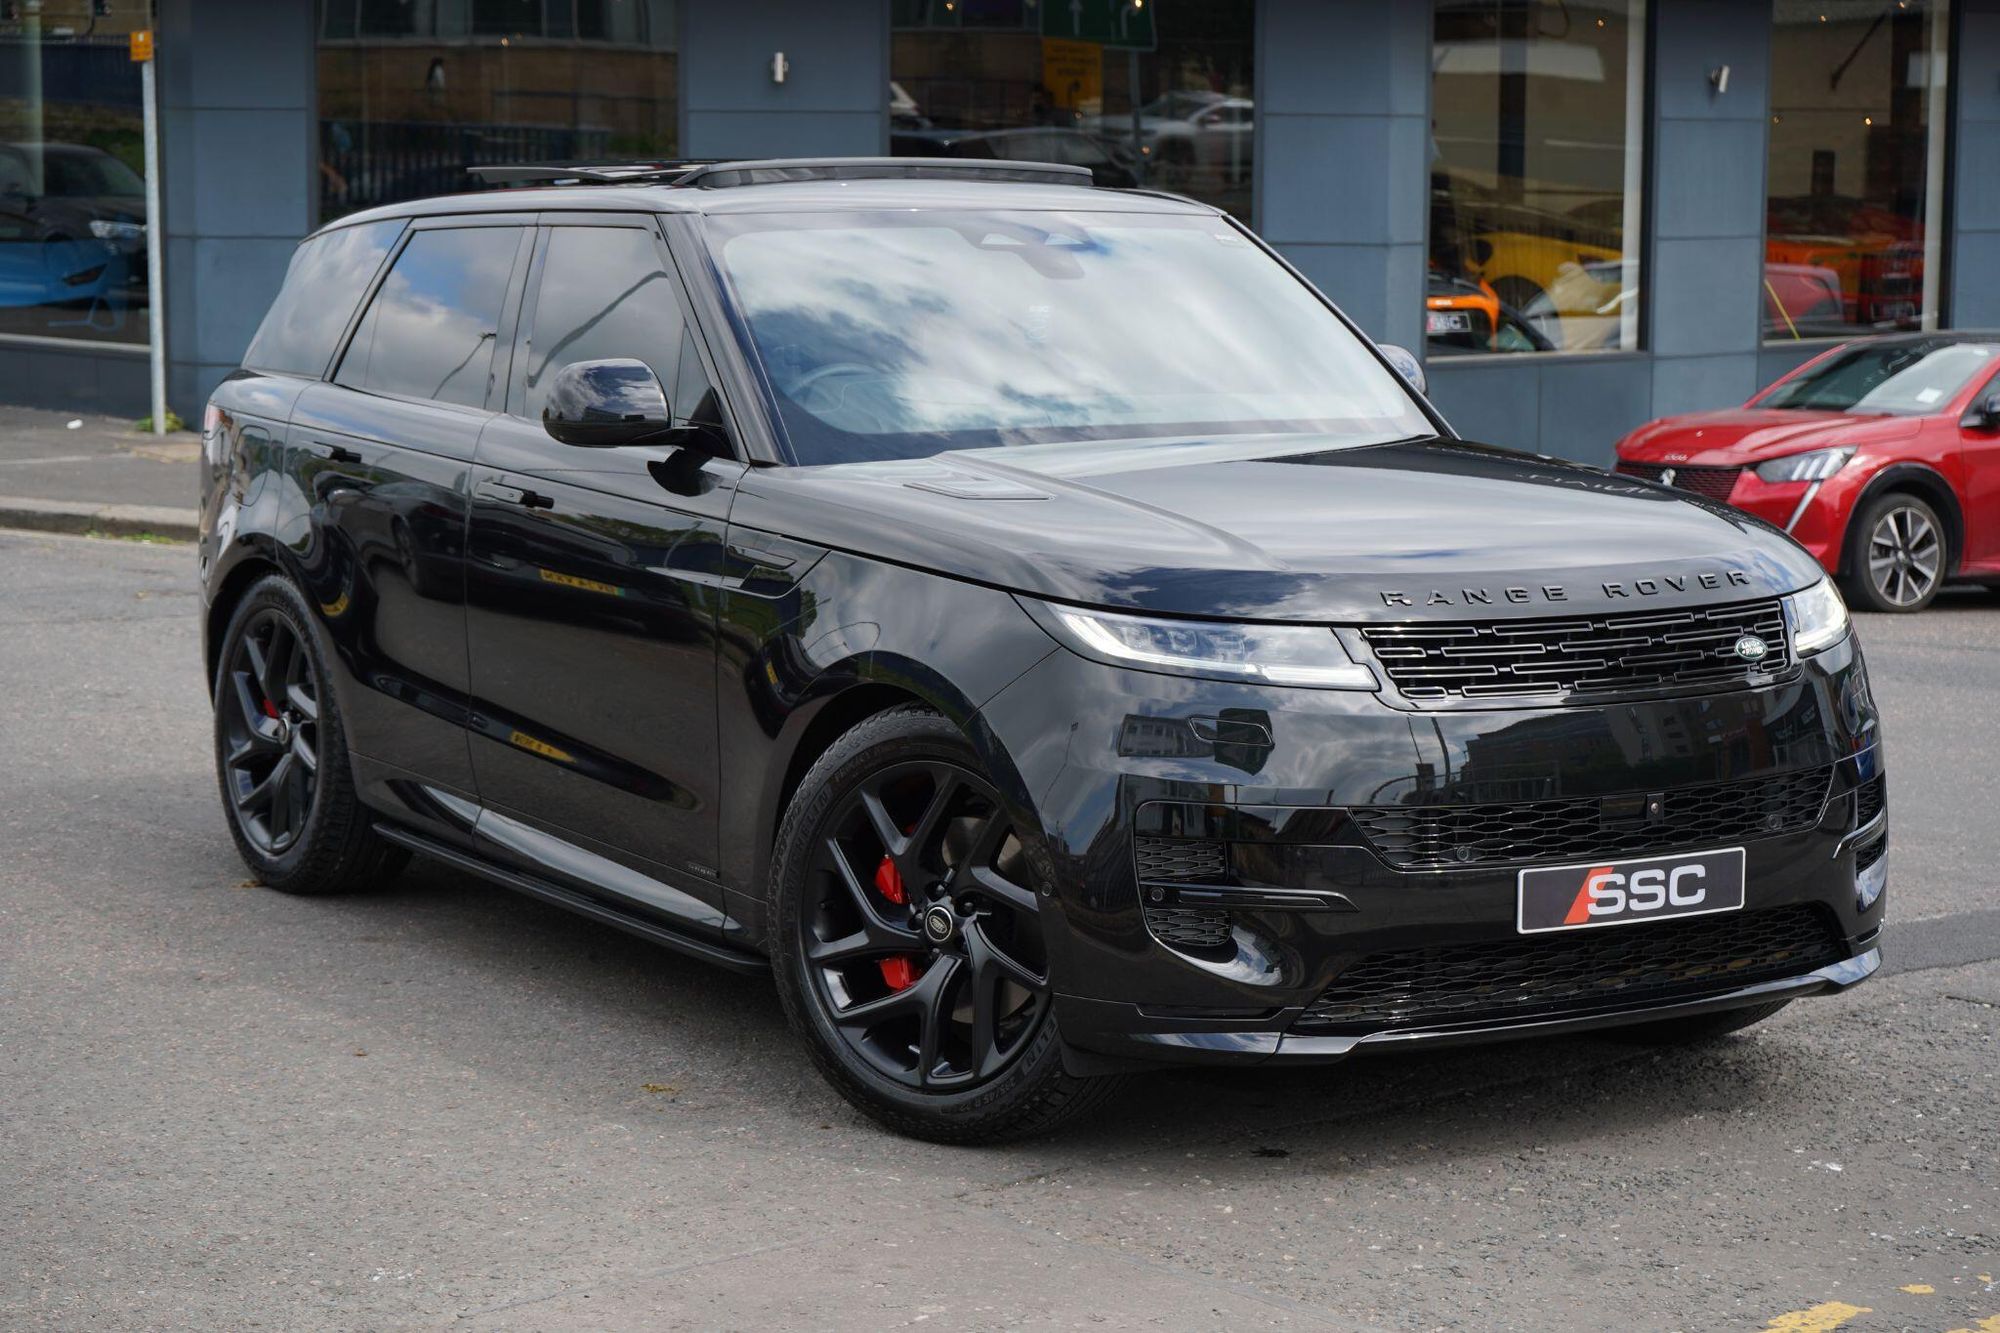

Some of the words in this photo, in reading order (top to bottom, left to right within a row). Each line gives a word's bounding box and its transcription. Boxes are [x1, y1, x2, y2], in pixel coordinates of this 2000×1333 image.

[1380, 585, 1569, 607] RANGE
[1602, 570, 1751, 599] ROVER
[1587, 863, 1706, 915] SSC
